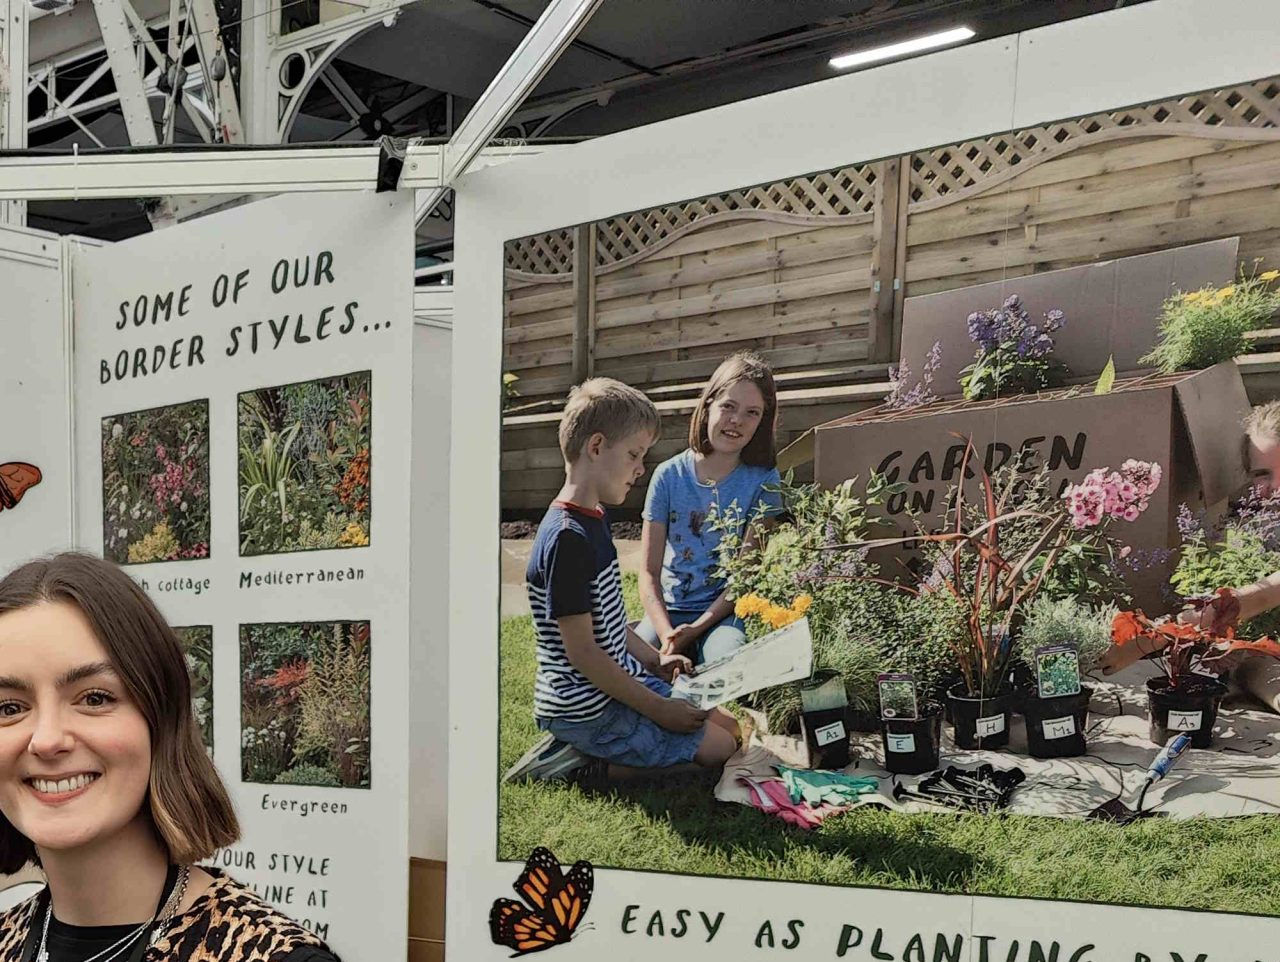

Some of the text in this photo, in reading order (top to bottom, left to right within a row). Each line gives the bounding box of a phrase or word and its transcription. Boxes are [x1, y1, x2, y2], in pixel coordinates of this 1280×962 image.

[116, 251, 335, 330] SOME OF OUR
[100, 302, 391, 385] BORDER STYLES...
[874, 432, 1087, 485] GARDEN
[886, 489, 934, 515] ON
[158, 577, 211, 594] cottage
[239, 567, 364, 588] Mediterranean
[985, 723, 996, 733] H
[261, 794, 348, 816] Evergreen
[269, 854, 330, 876] STYLE
[307, 890, 328, 908] AT
[620, 905, 725, 943] EASY
[755, 920, 804, 950] AS
